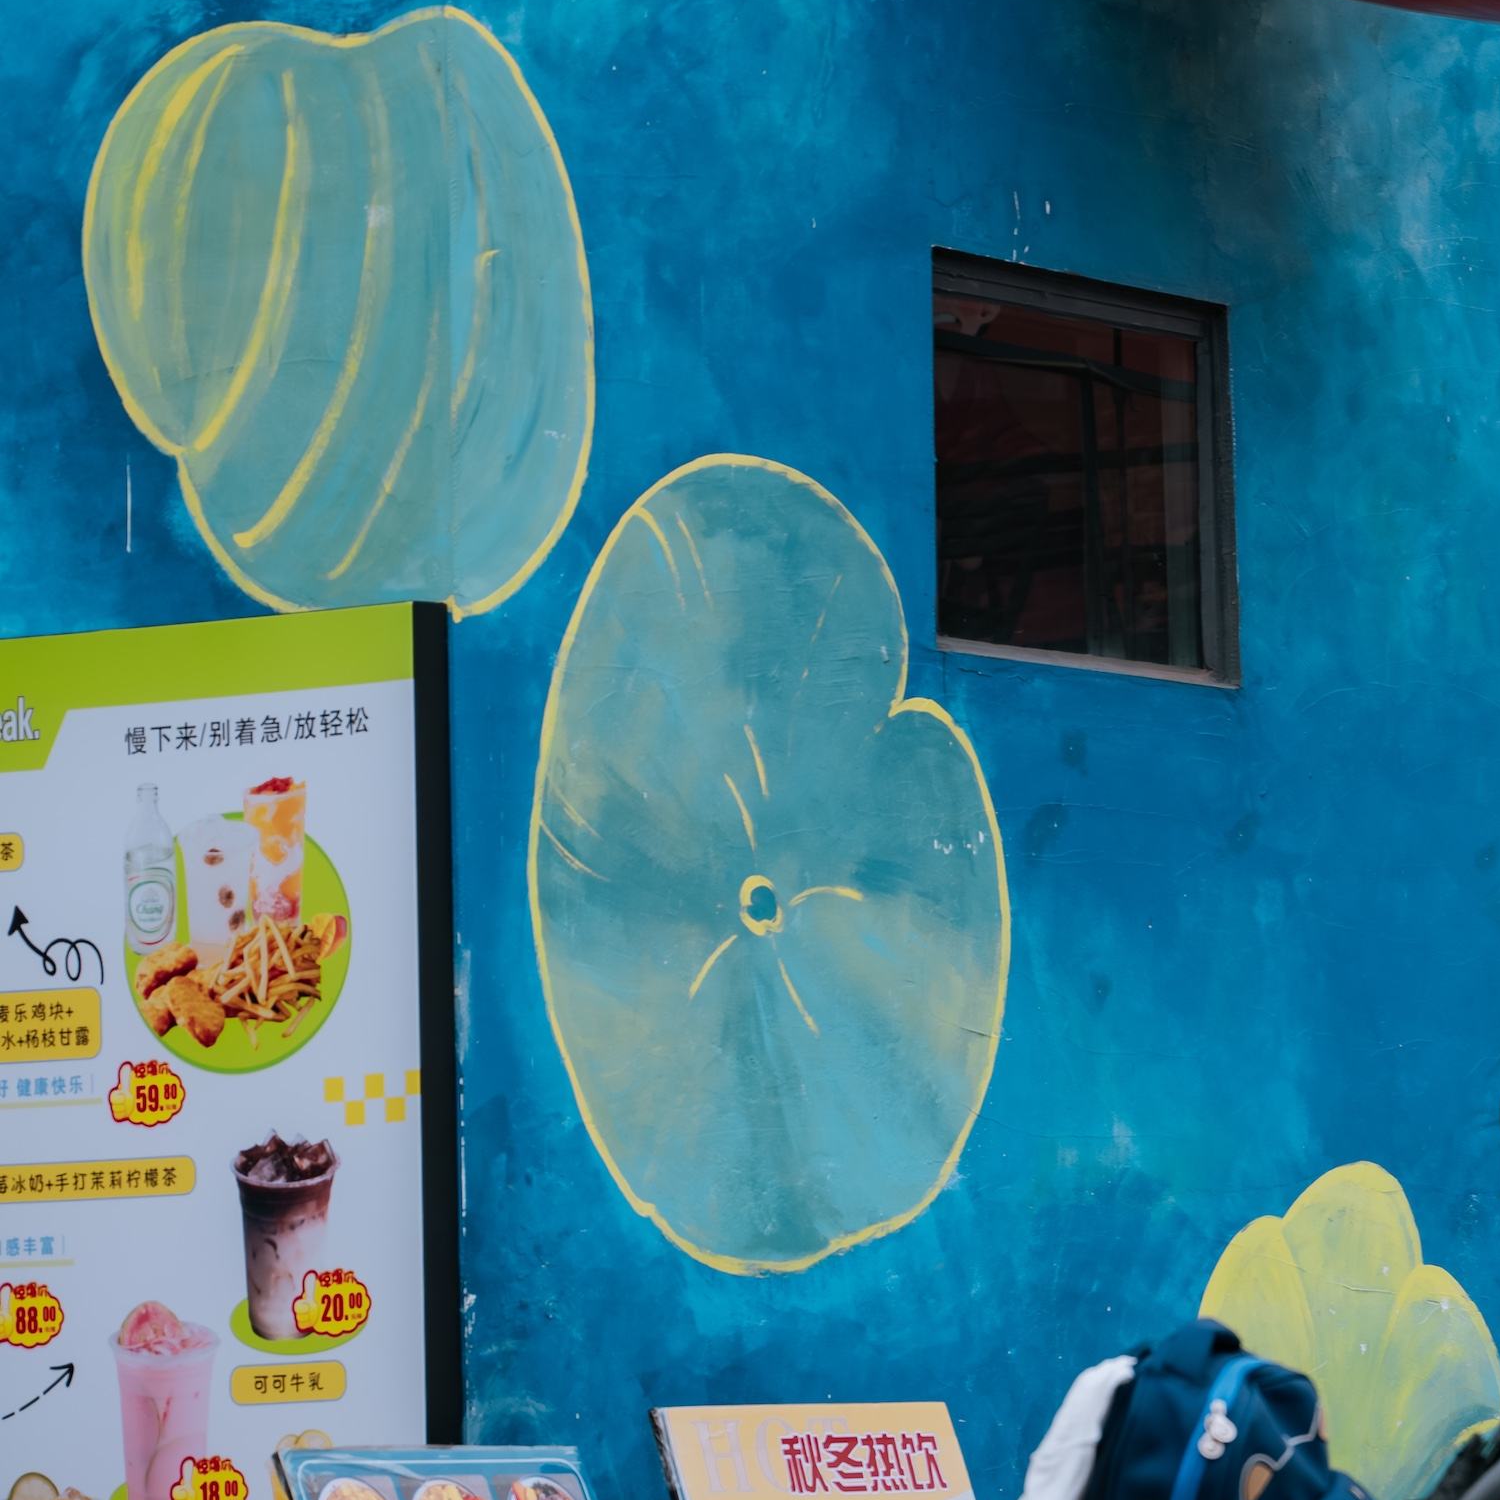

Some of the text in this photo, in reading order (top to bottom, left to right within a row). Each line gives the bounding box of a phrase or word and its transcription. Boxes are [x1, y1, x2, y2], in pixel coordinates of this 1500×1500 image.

[0, 696, 40, 742] ak.
[125, 706, 370, 756] 慢下来/别着急/放轻松
[0, 1236, 55, 1257] 感丰富
[253, 1372, 324, 1395] 可可牛乳
[780, 1431, 949, 1494] 秋冬热饮
